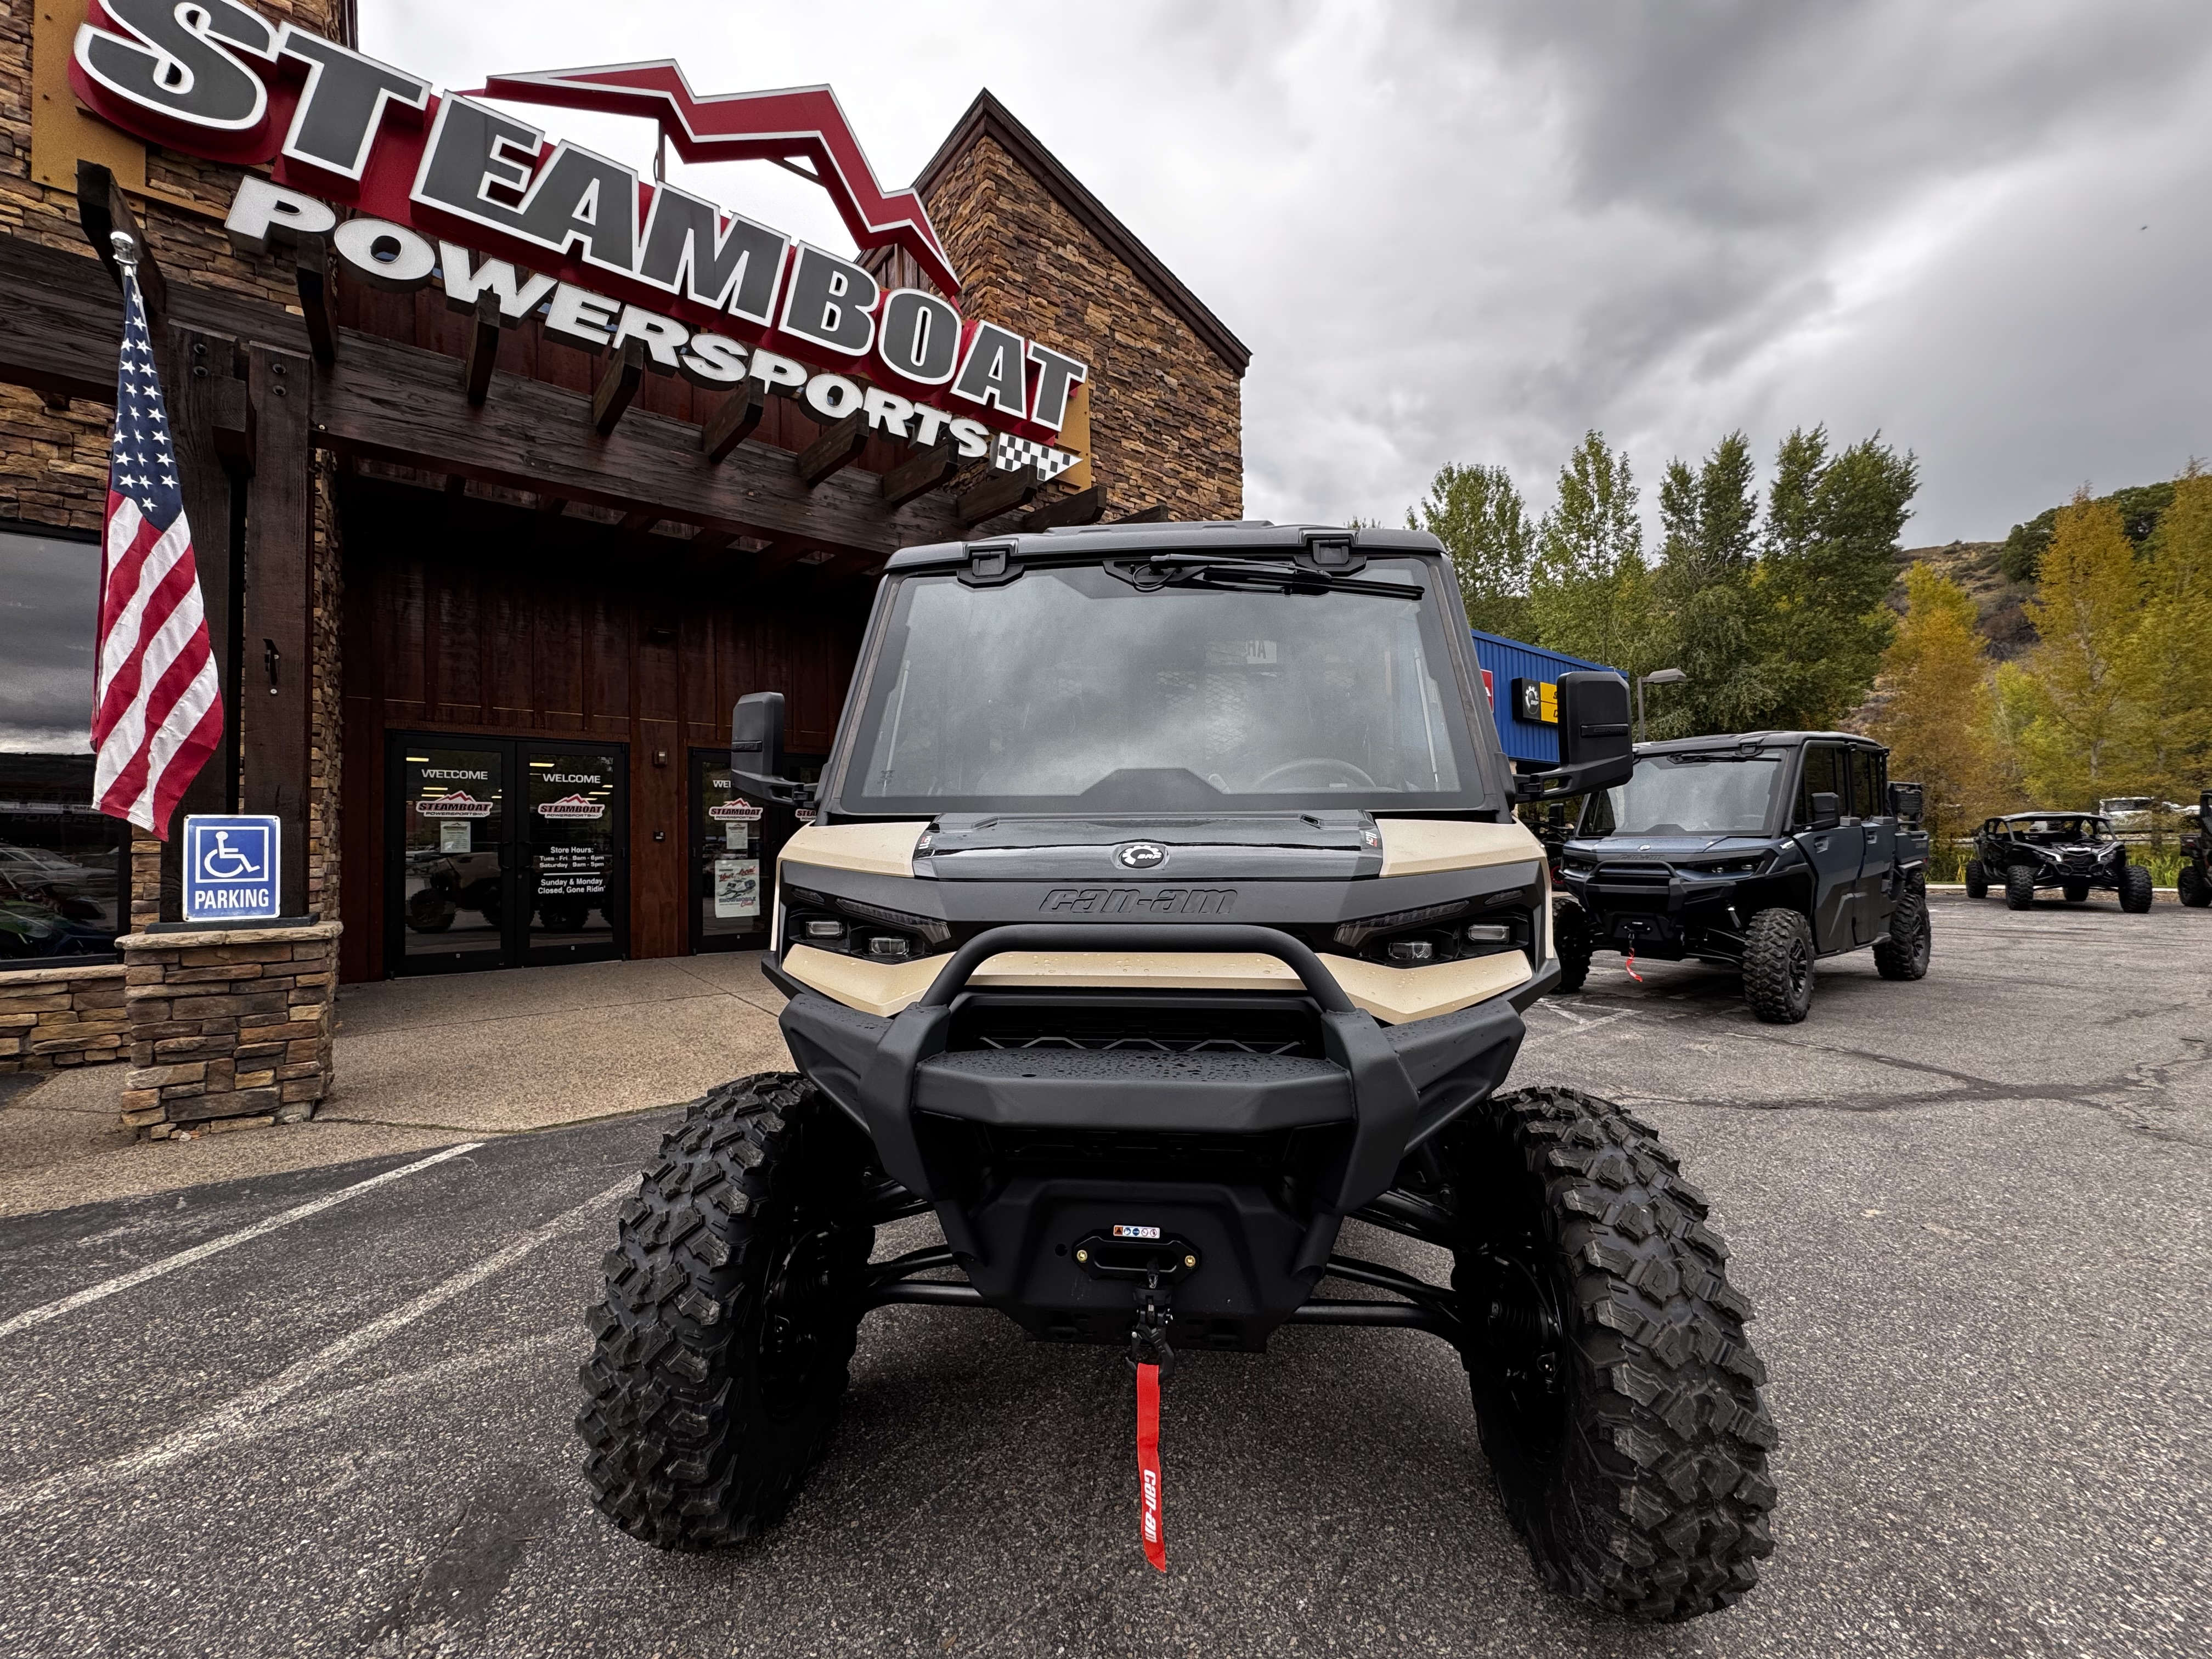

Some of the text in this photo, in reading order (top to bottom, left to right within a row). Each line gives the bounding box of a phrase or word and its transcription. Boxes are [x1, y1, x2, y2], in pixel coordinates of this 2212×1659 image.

[73, 0, 1087, 432] STEAMBOAT
[225, 176, 990, 459] POWERSPORTS
[421, 769, 488, 780] WELCOME
[543, 774, 601, 783] WELCOME
[419, 803, 491, 811] STEAMBOAT
[540, 805, 603, 814] STEAMBOAT
[195, 888, 269, 910] PARKING
[1039, 889, 1238, 915] can-am
[1143, 1469, 1158, 1543] can-am
